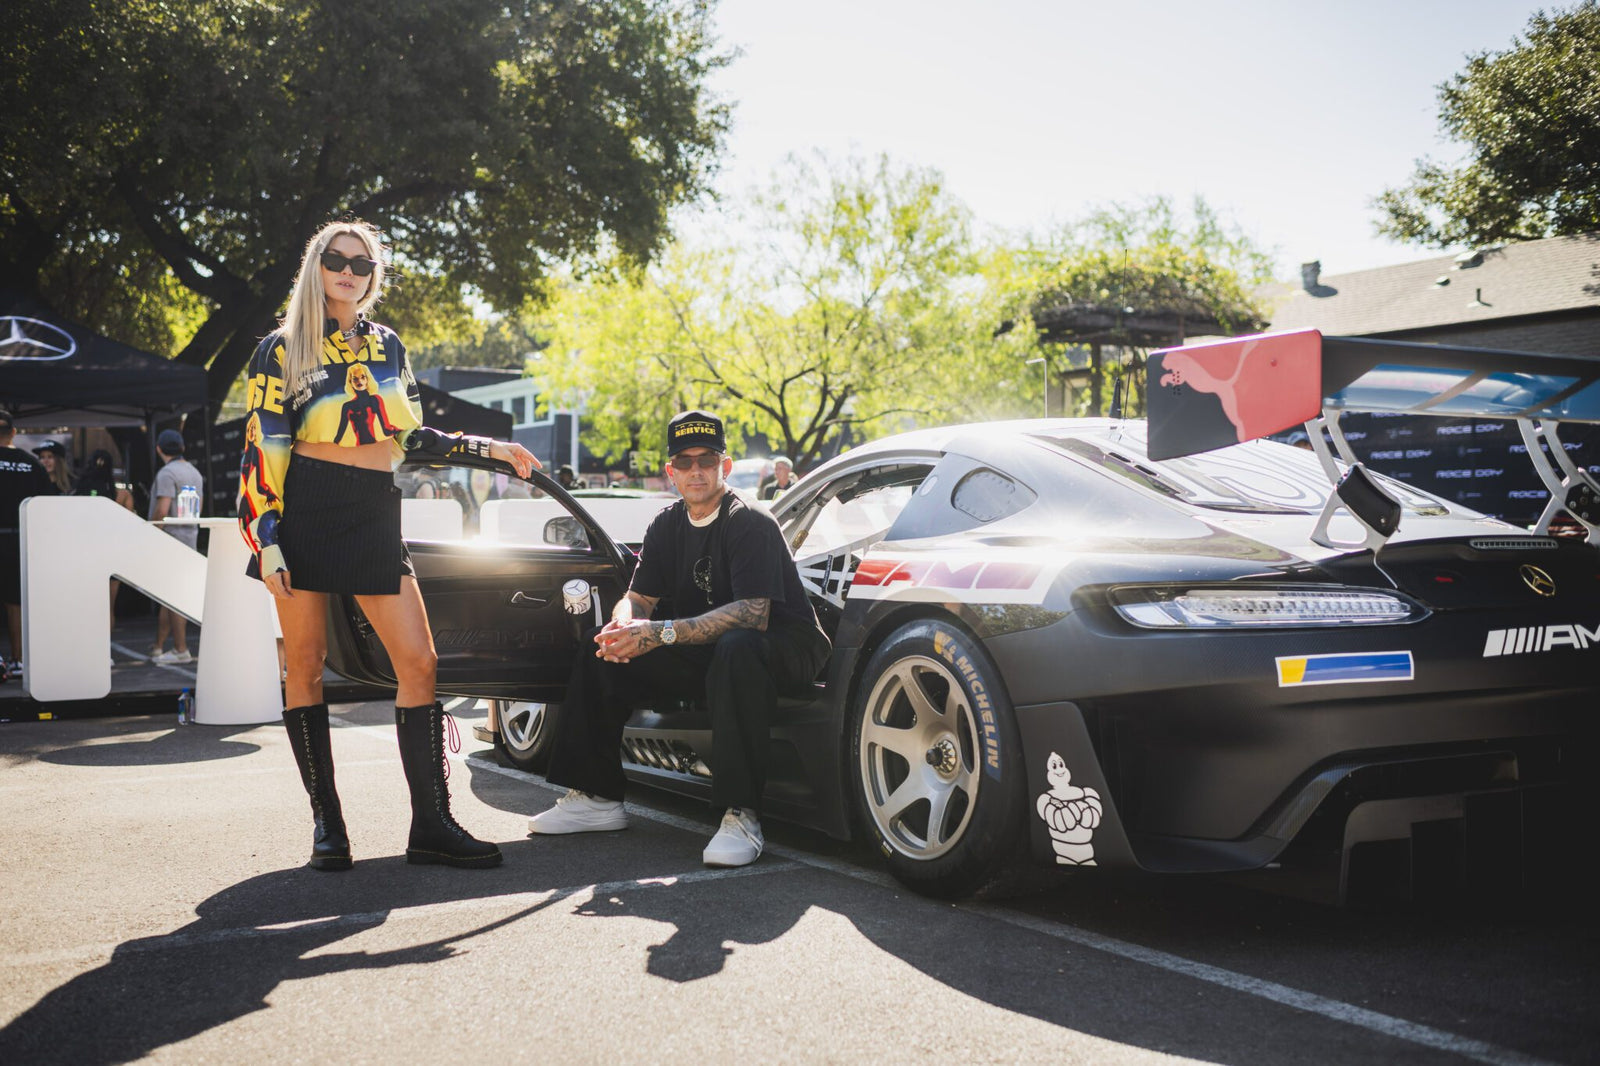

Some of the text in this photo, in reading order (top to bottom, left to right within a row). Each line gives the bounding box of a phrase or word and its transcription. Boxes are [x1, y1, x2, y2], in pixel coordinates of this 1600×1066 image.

[675, 426, 716, 437] SERVICE
[1436, 423, 1504, 435] RACE DAY
[1509, 443, 1548, 453] RAE
[1370, 449, 1432, 460] RACE DAY
[1436, 468, 1503, 478] RACE DAY
[1509, 490, 1547, 499] RACE
[956, 655, 999, 769] MICHELIN
